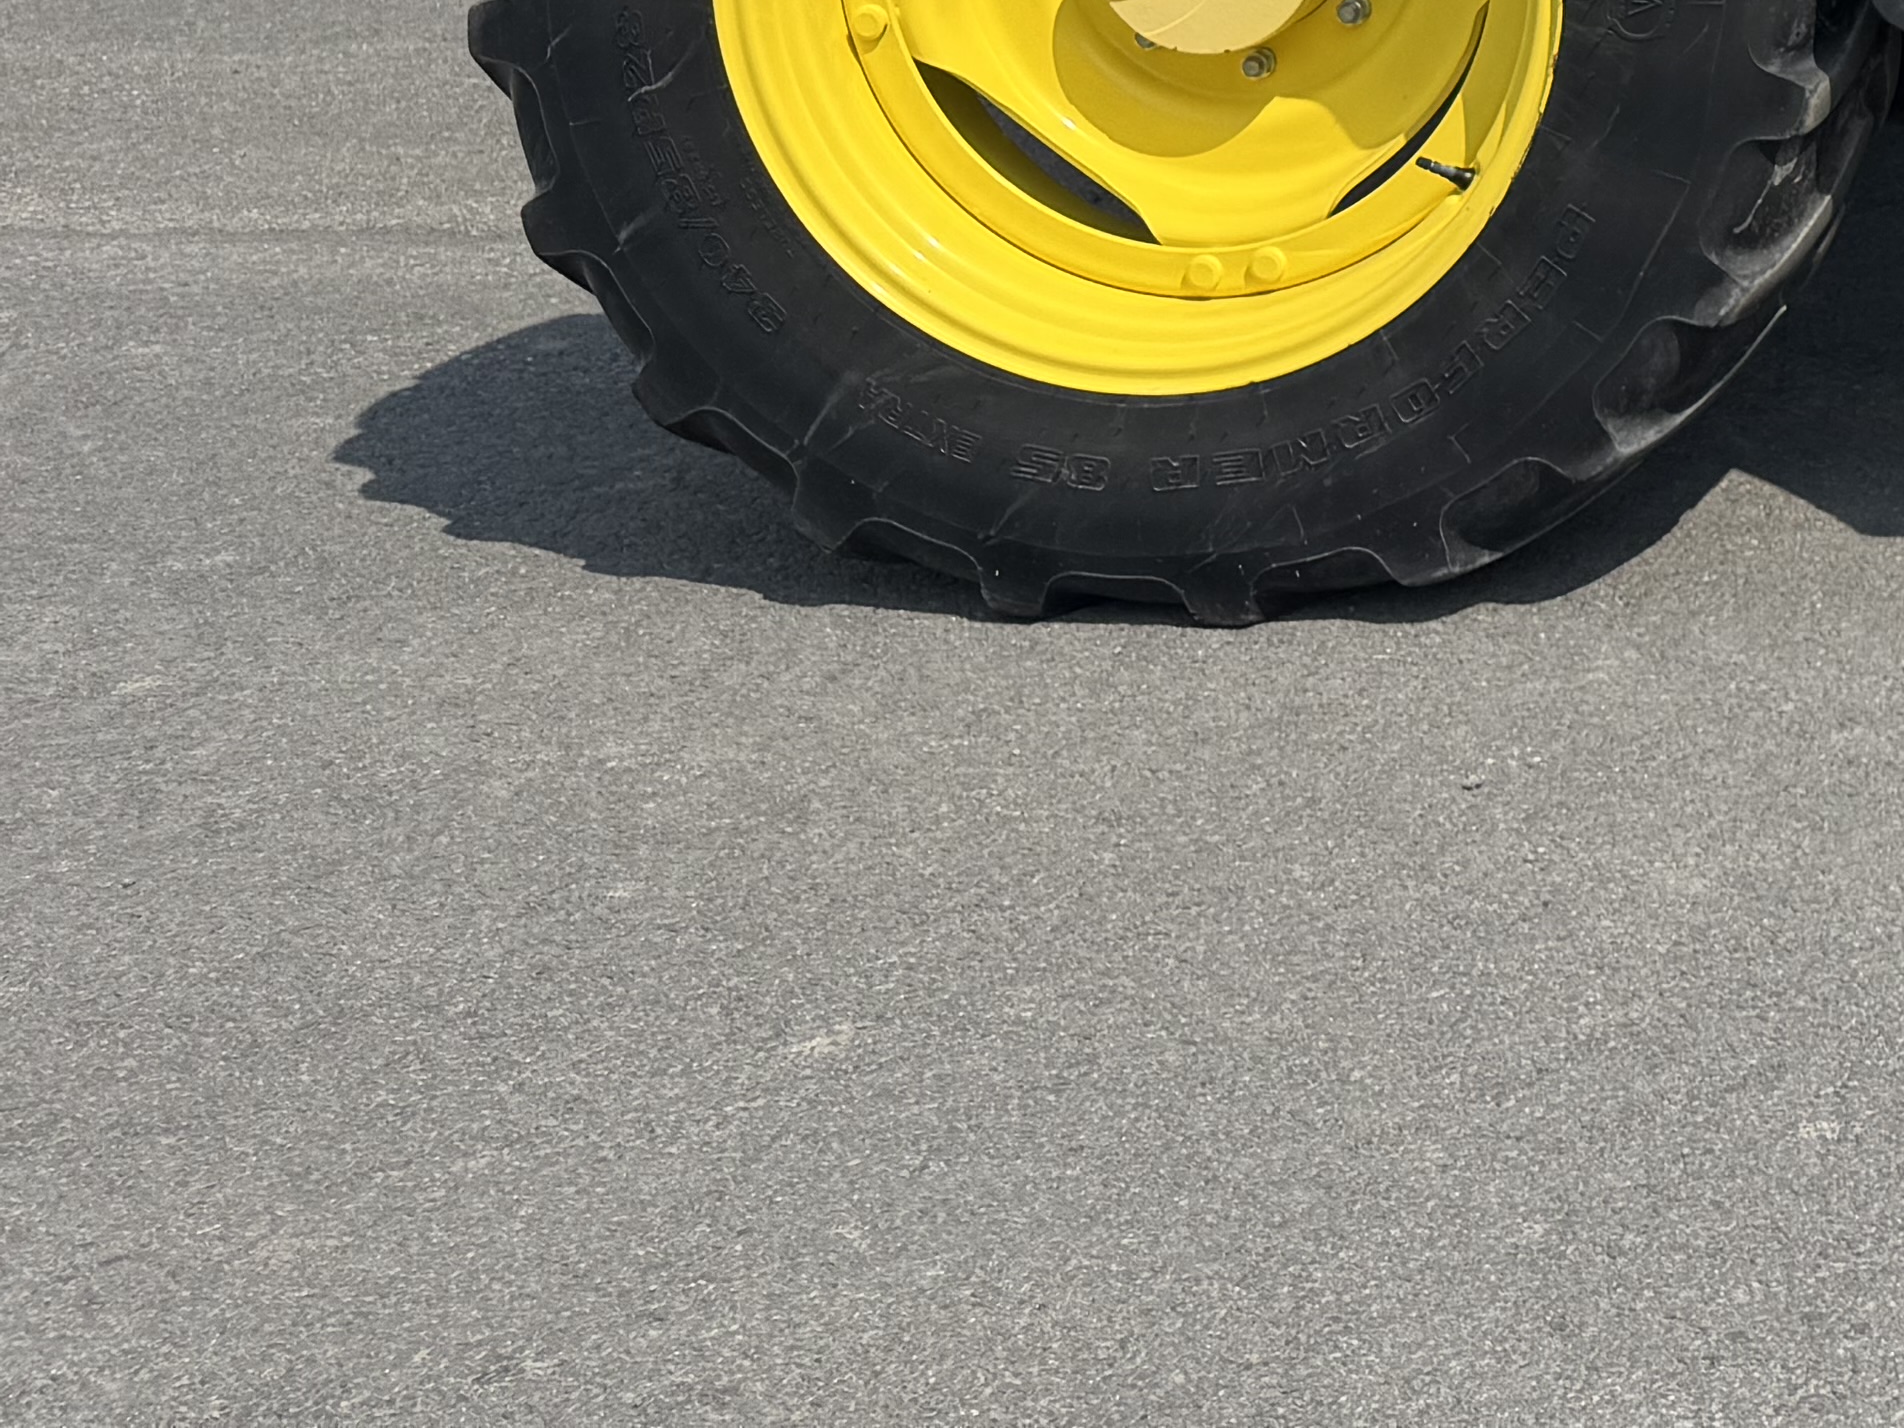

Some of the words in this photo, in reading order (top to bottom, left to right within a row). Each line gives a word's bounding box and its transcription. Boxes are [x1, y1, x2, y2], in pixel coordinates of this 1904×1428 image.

[1151, 202, 1597, 493] PERFORMER
[858, 377, 983, 464] EXTRA
[1010, 443, 1112, 491] 85
